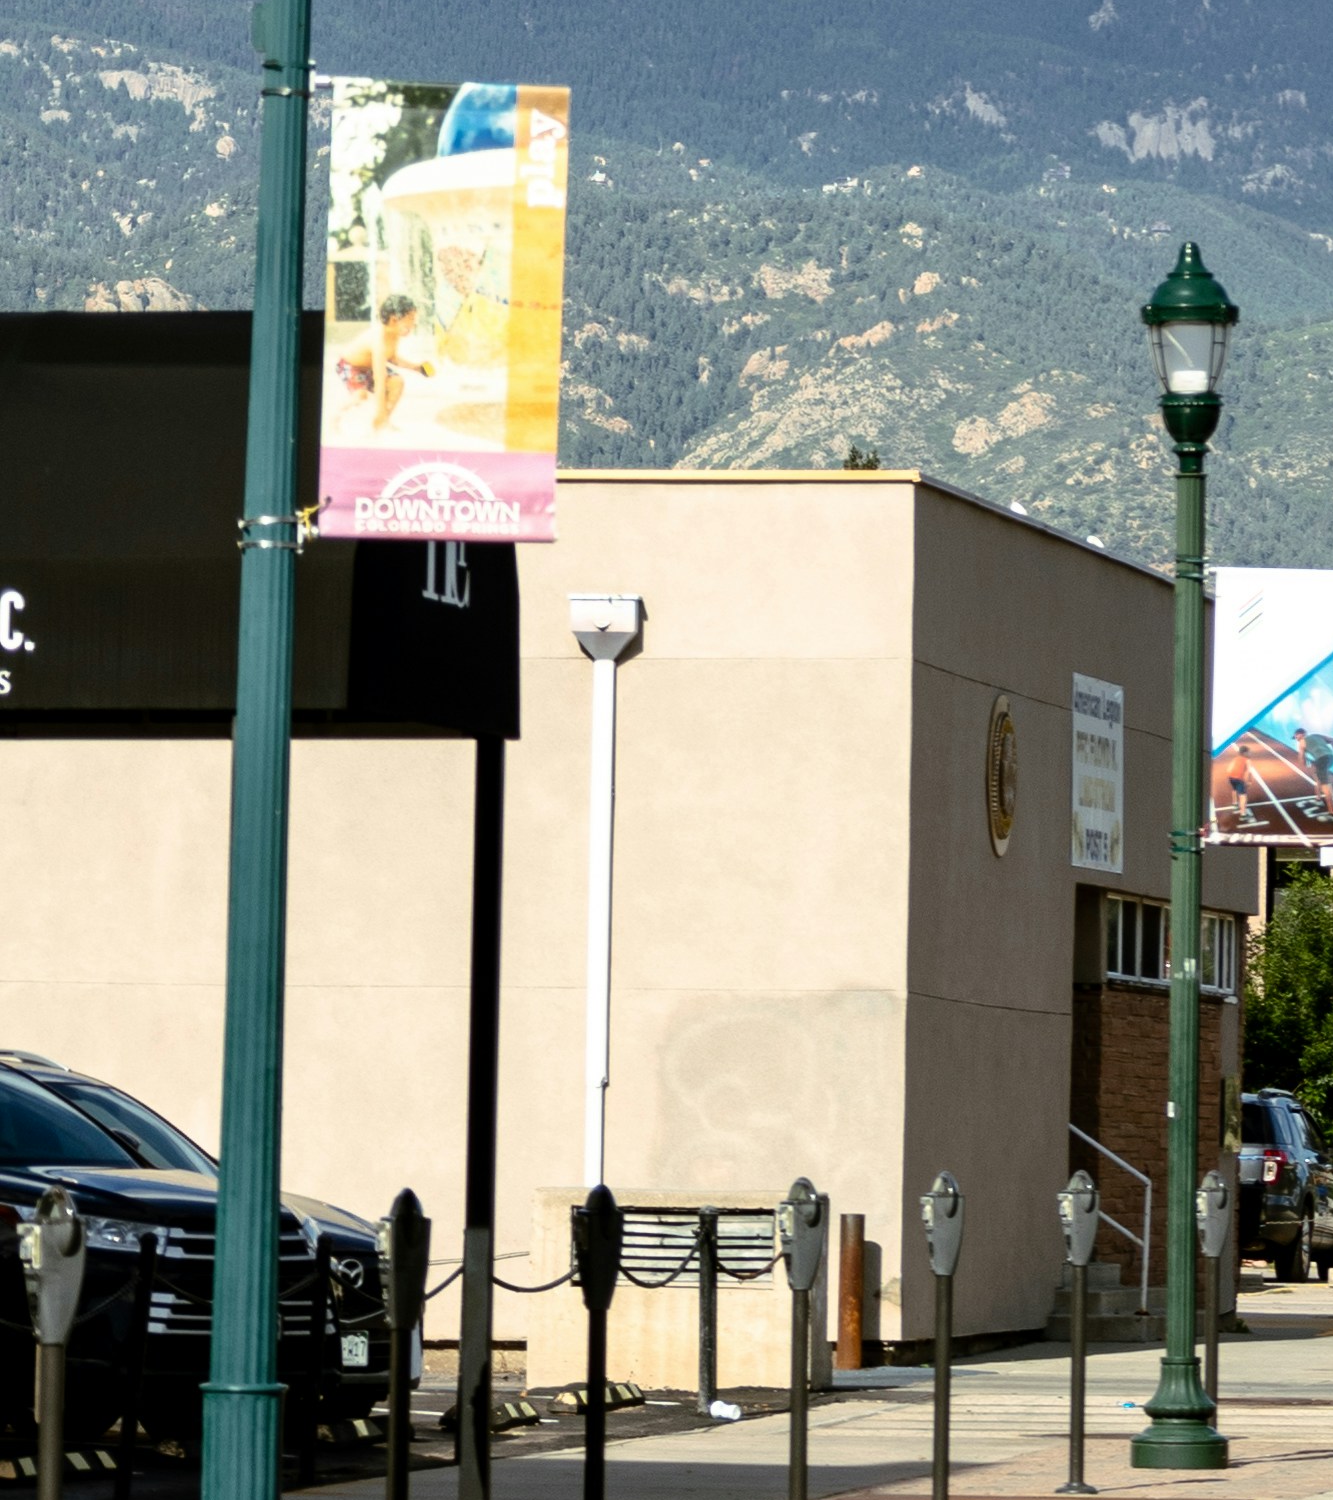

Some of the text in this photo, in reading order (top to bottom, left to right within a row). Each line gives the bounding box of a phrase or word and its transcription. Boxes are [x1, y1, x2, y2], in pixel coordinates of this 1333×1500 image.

[519, 107, 567, 208] play
[355, 497, 521, 523] DOWNTOWN
[355, 519, 520, 535] COLORADO SPRINGS
